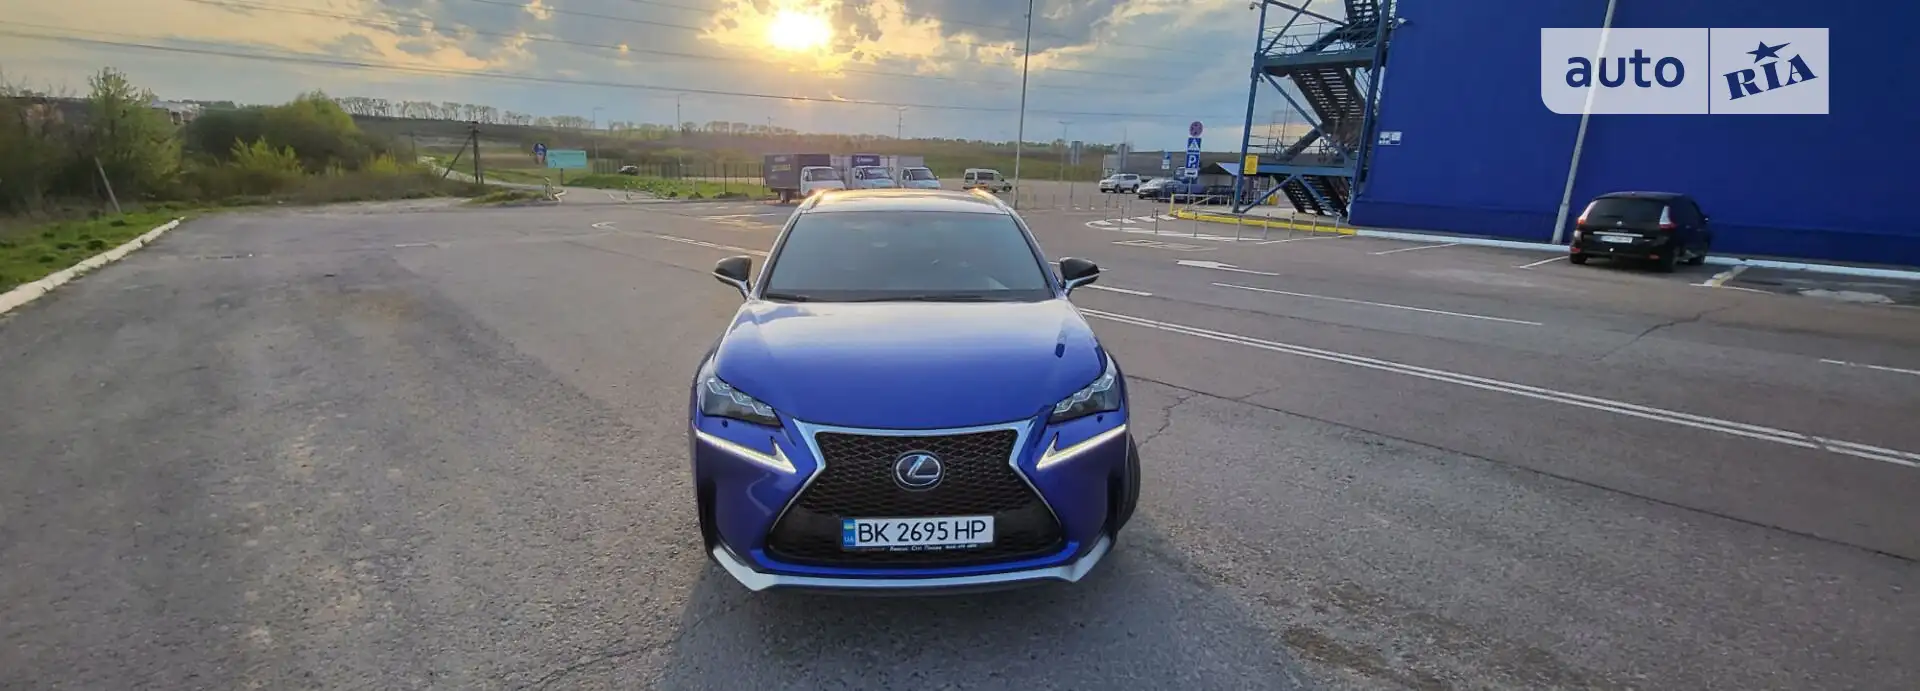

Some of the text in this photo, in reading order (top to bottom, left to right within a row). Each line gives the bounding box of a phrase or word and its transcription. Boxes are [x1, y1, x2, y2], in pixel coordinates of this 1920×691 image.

[858, 520, 986, 543] BK 2695 HP
